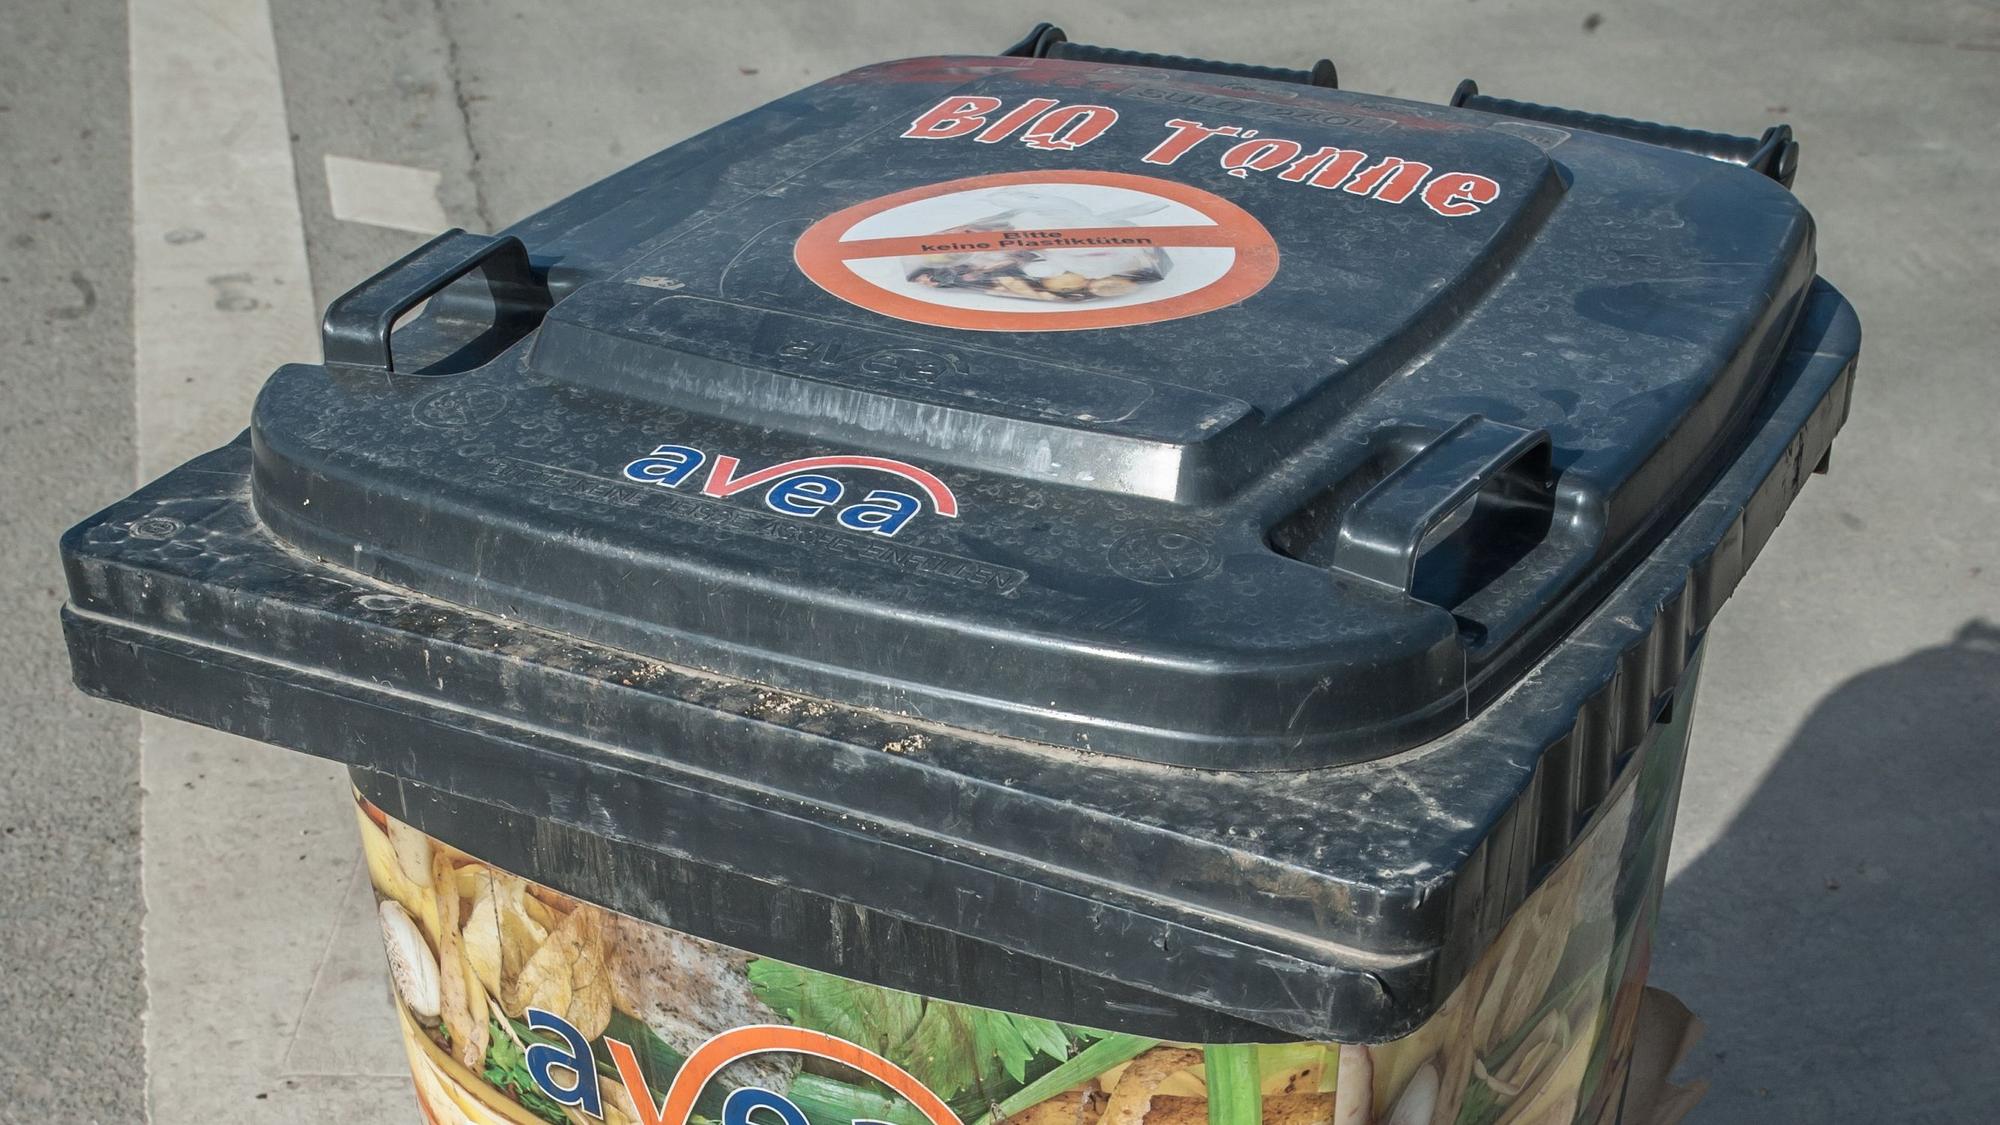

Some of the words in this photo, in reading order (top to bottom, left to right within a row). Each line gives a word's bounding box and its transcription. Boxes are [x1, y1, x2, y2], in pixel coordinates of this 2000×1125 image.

[1141, 118, 1501, 218] Tonne
[921, 242, 991, 252] keine
[998, 236, 1153, 249] Plastiktüten
[1002, 231, 1063, 240] Bitte
[622, 444, 958, 538] avea
